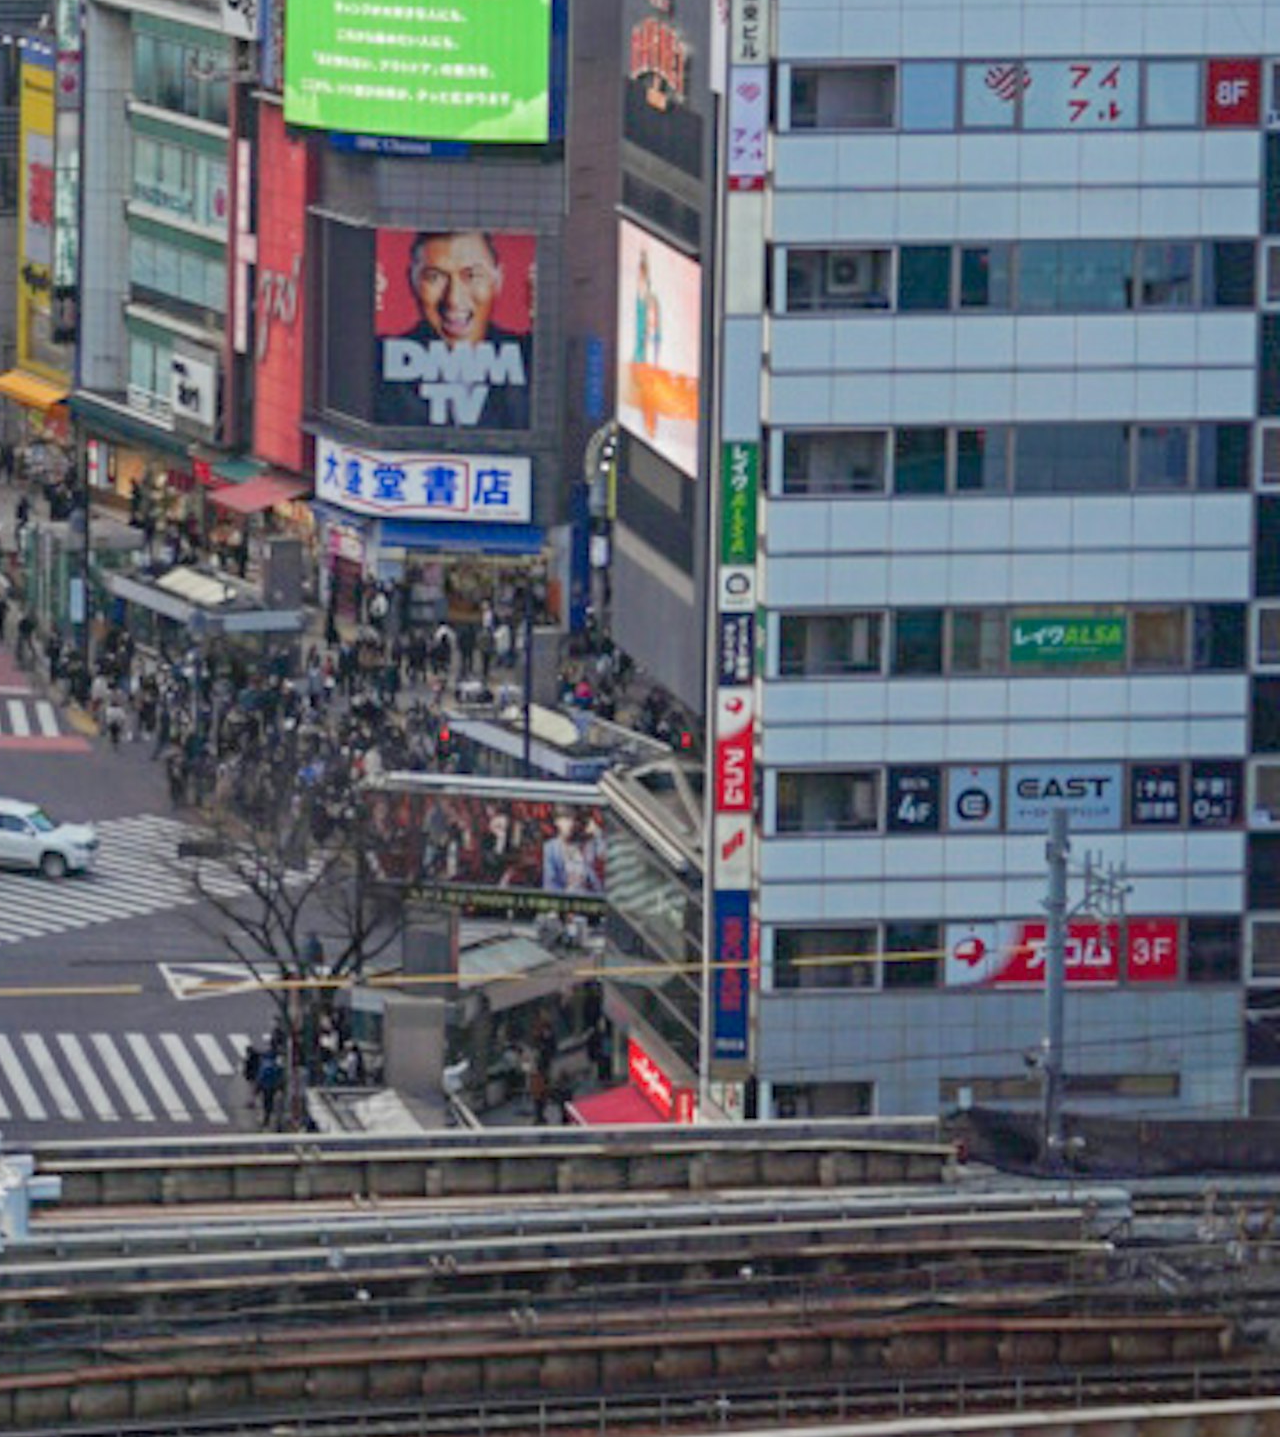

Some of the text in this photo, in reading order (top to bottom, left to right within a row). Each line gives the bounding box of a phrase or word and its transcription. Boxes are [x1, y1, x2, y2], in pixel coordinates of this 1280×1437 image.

[1215, 79, 1249, 107] 8F
[383, 338, 526, 387] DMM
[420, 383, 490, 426] TV
[1017, 778, 1113, 799] EAST
[897, 792, 932, 825] 4F
[1131, 937, 1172, 965] 3F
